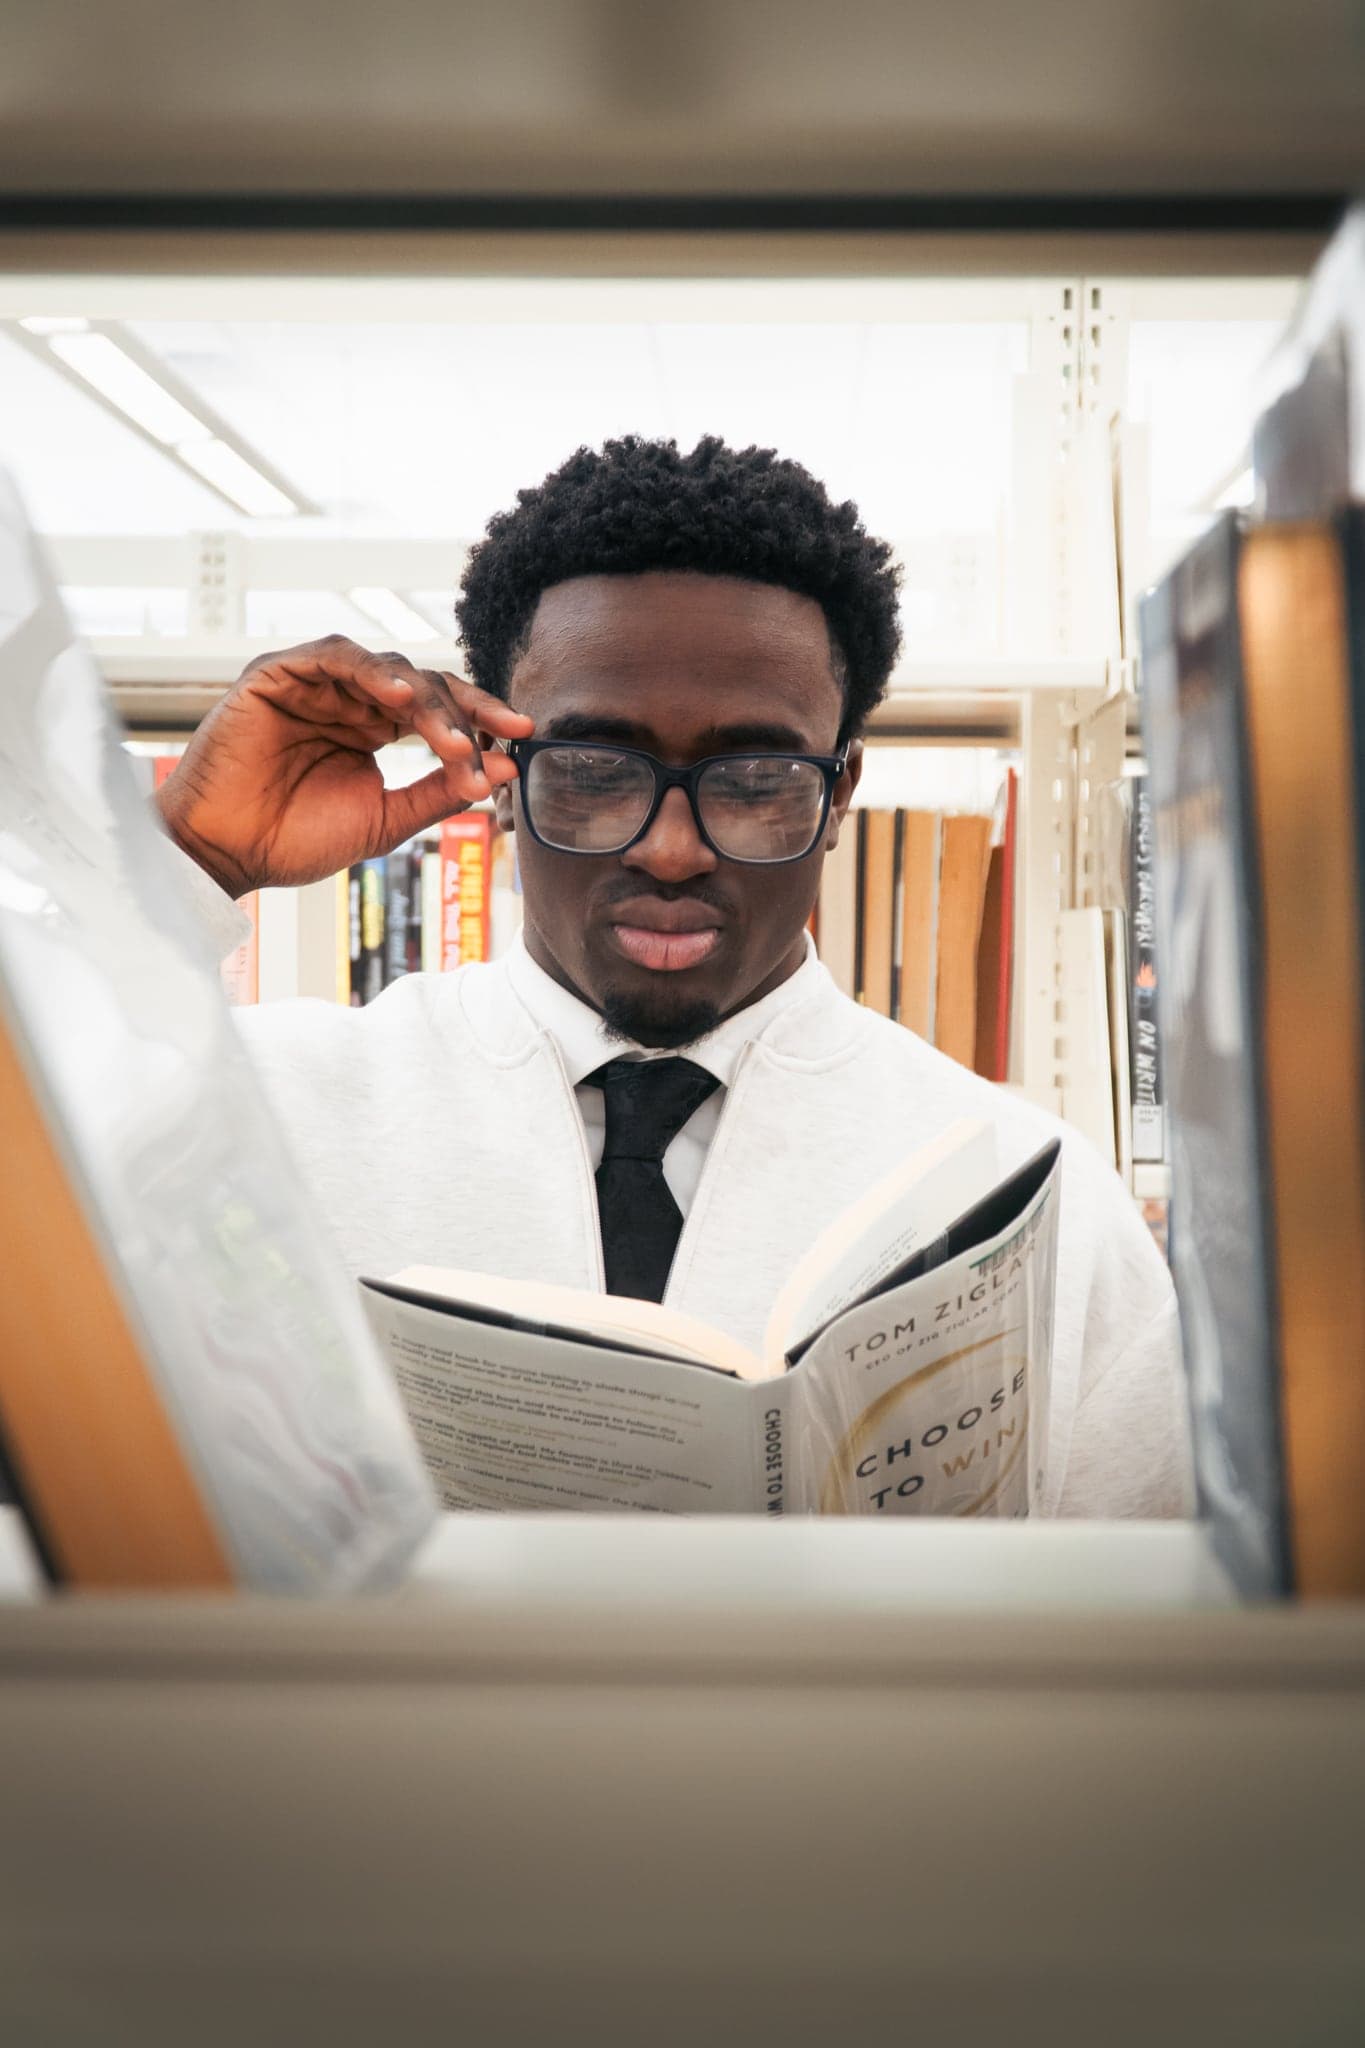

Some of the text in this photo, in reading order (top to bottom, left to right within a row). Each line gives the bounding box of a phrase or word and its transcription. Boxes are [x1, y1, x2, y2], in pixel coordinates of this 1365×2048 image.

[1138, 1019, 1157, 1050] ON
[845, 1318, 916, 1362] TOM
[866, 1355, 890, 1370] CEO
[897, 1340, 913, 1355] OF
[919, 1332, 940, 1346] ZIG
[945, 1306, 989, 1333] ZIGLAR
[765, 1408, 782, 1472] CHOOSE
[856, 1367, 1025, 1478] CHOOSE
[767, 1472, 783, 1495] TO
[870, 1417, 1016, 1509] TO WIN
